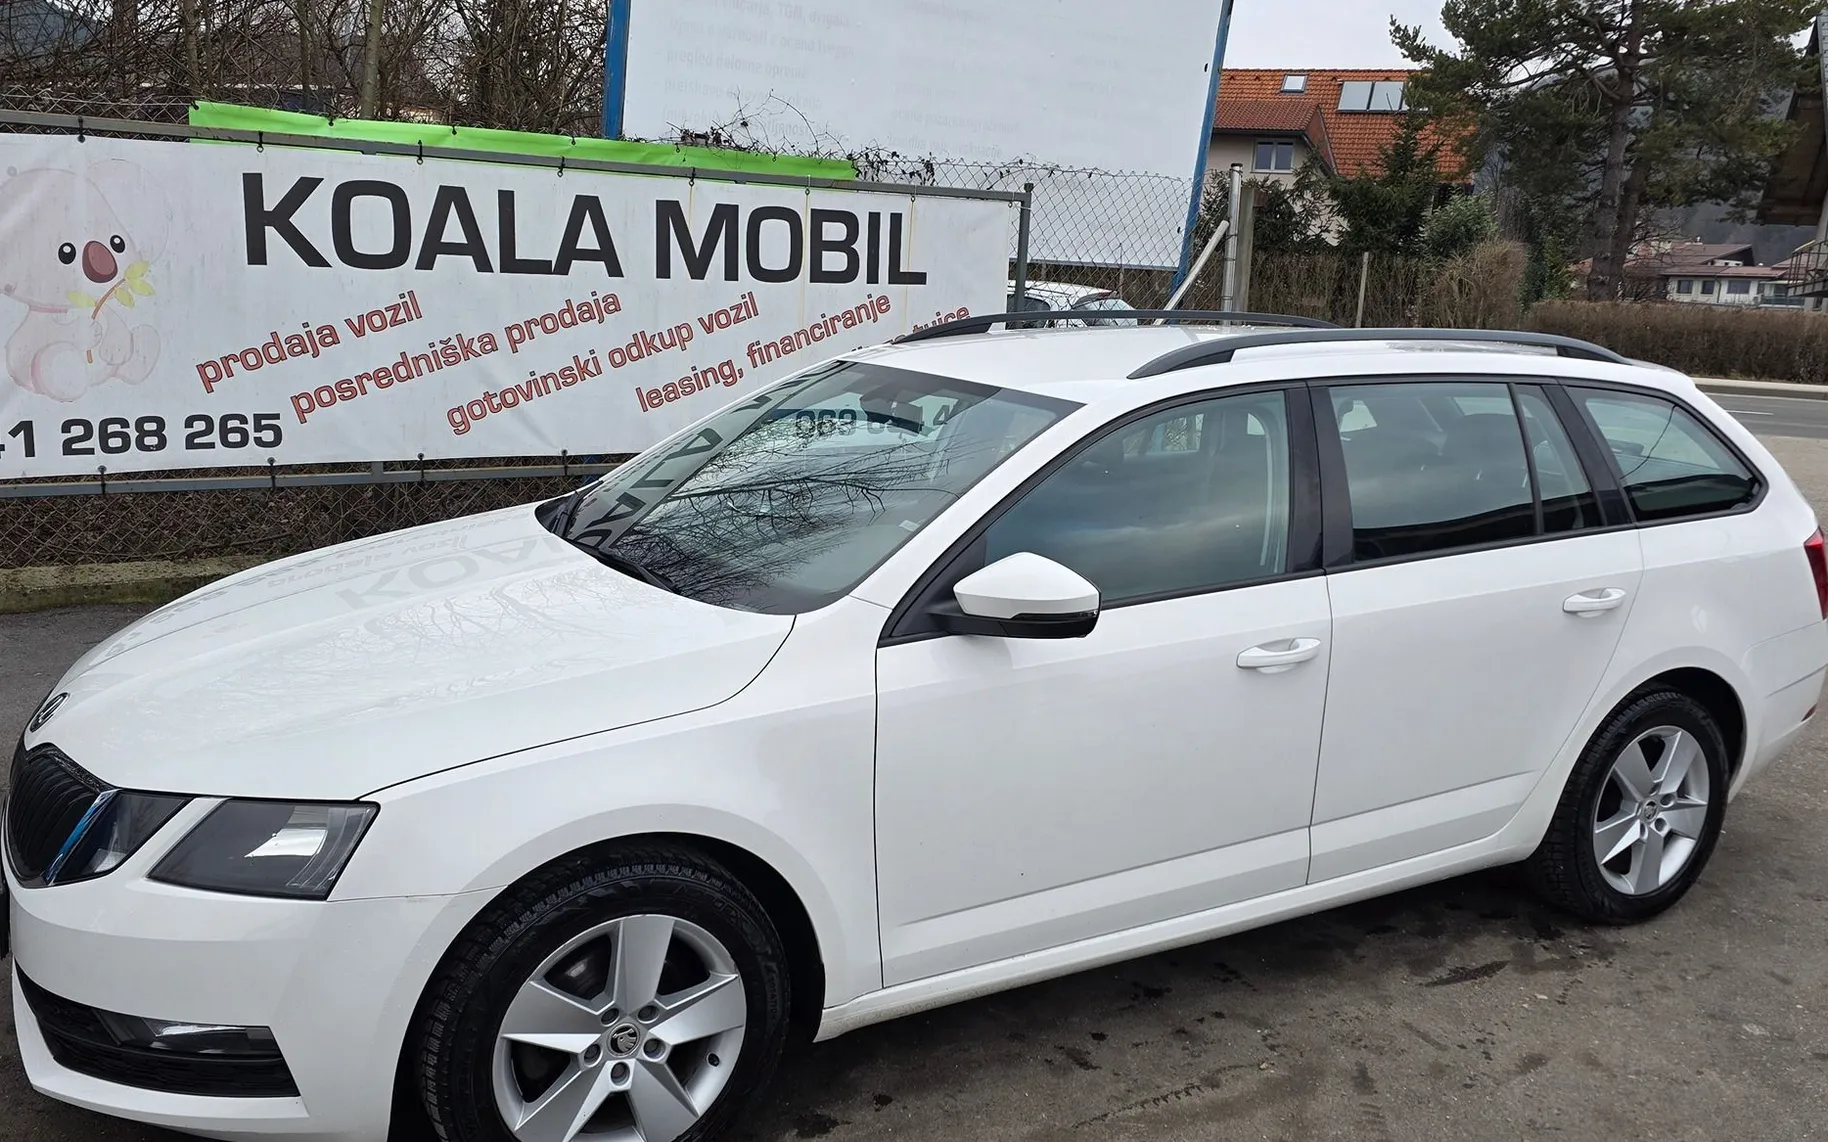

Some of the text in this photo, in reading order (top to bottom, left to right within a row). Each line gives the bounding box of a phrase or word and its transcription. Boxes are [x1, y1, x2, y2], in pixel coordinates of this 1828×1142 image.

[242, 172, 927, 285] KOALA MOBIL
[196, 290, 423, 393] prodaja vozil
[290, 291, 621, 424] posredniška prodaja
[447, 291, 758, 435] gotovinski odkup vozil
[636, 359, 744, 412] leasing,
[746, 293, 891, 368] financiranje
[0, 413, 282, 458] 1 268 265
